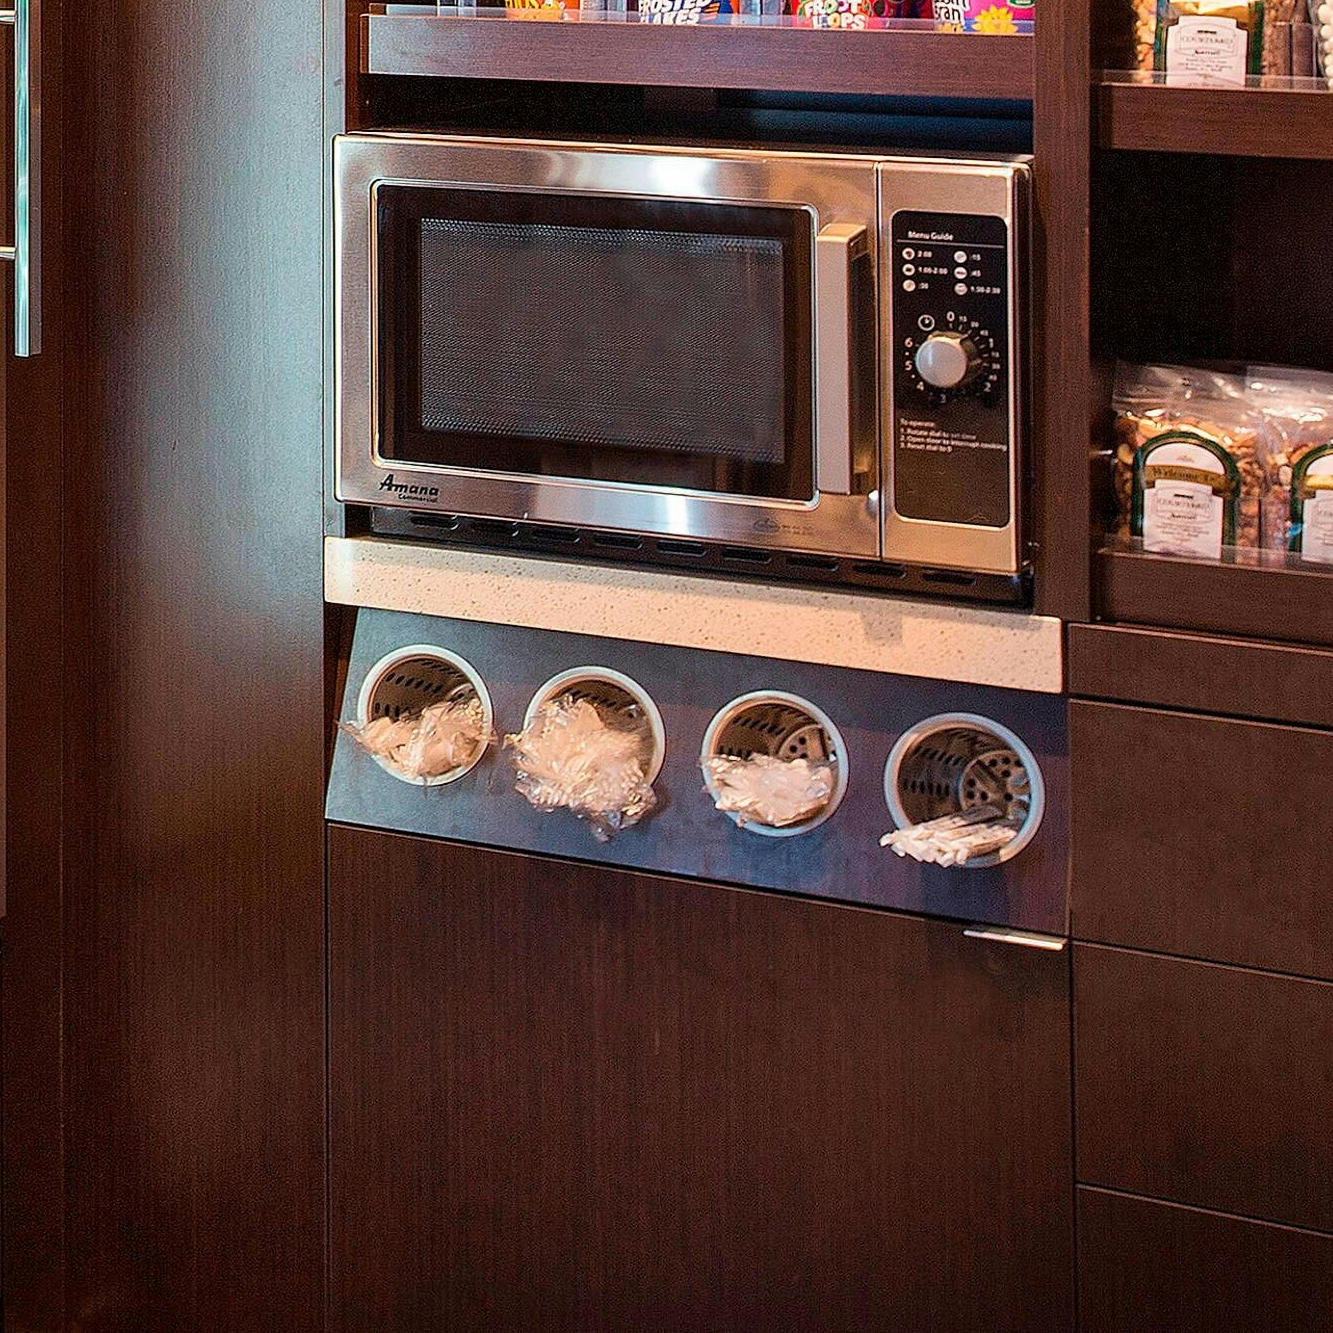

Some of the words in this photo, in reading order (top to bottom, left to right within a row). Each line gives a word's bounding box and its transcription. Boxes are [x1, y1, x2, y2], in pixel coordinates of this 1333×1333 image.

[907, 230, 930, 240] Menu
[930, 231, 954, 241] Guide
[946, 310, 956, 322] 0
[904, 337, 914, 348] 6
[904, 360, 913, 371] 5
[916, 381, 925, 392] 4
[983, 382, 992, 393] 2
[379, 473, 440, 497] Amana
